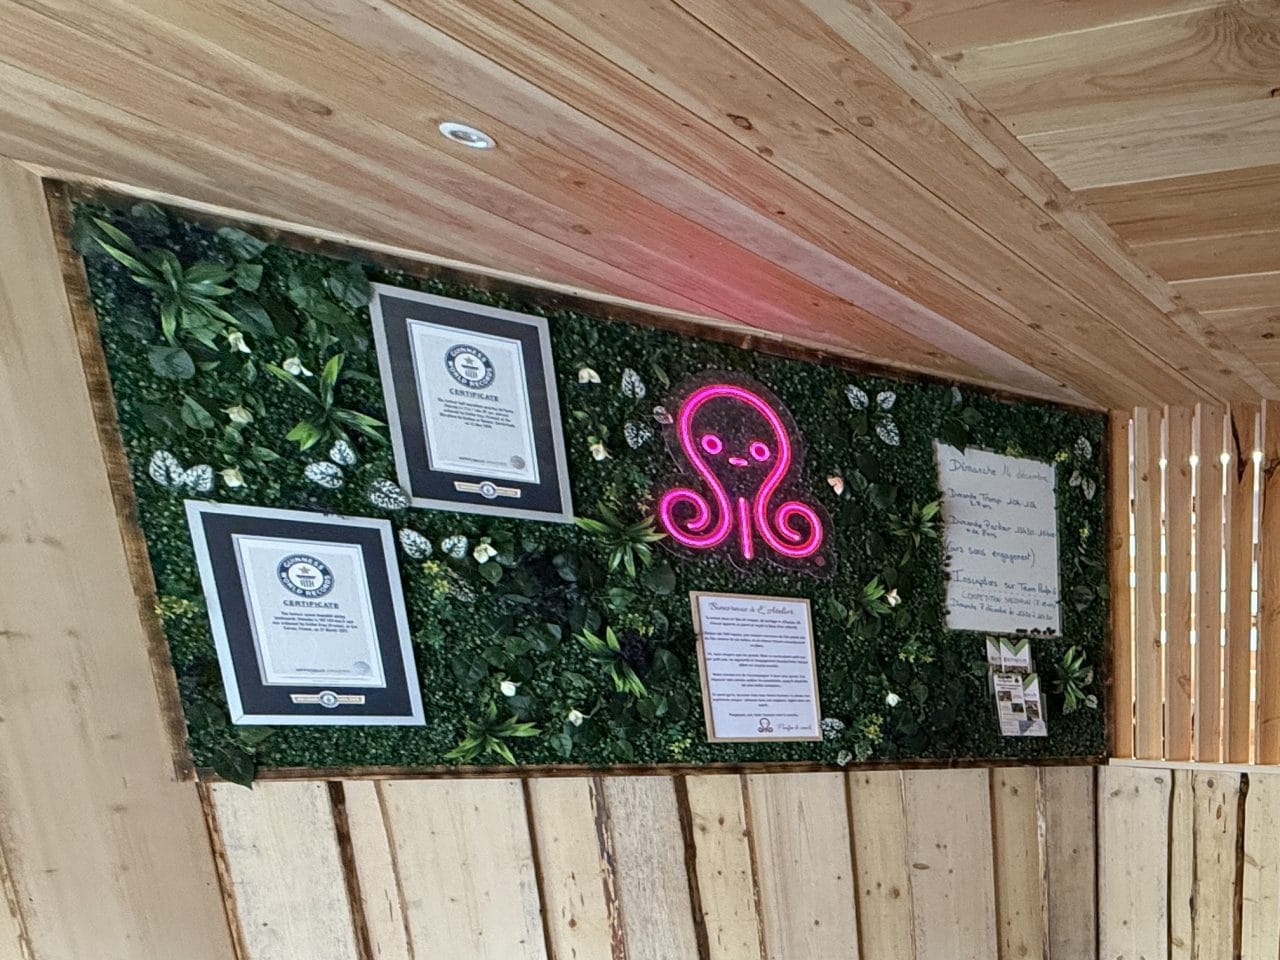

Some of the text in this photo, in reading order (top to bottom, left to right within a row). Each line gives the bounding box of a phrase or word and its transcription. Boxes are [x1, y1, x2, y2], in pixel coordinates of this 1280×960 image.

[450, 347, 486, 362] GUINNESS
[449, 388, 499, 402] CERTIFICATE
[283, 557, 325, 570] GUINNESS
[283, 599, 339, 609] CERTIFICATE
